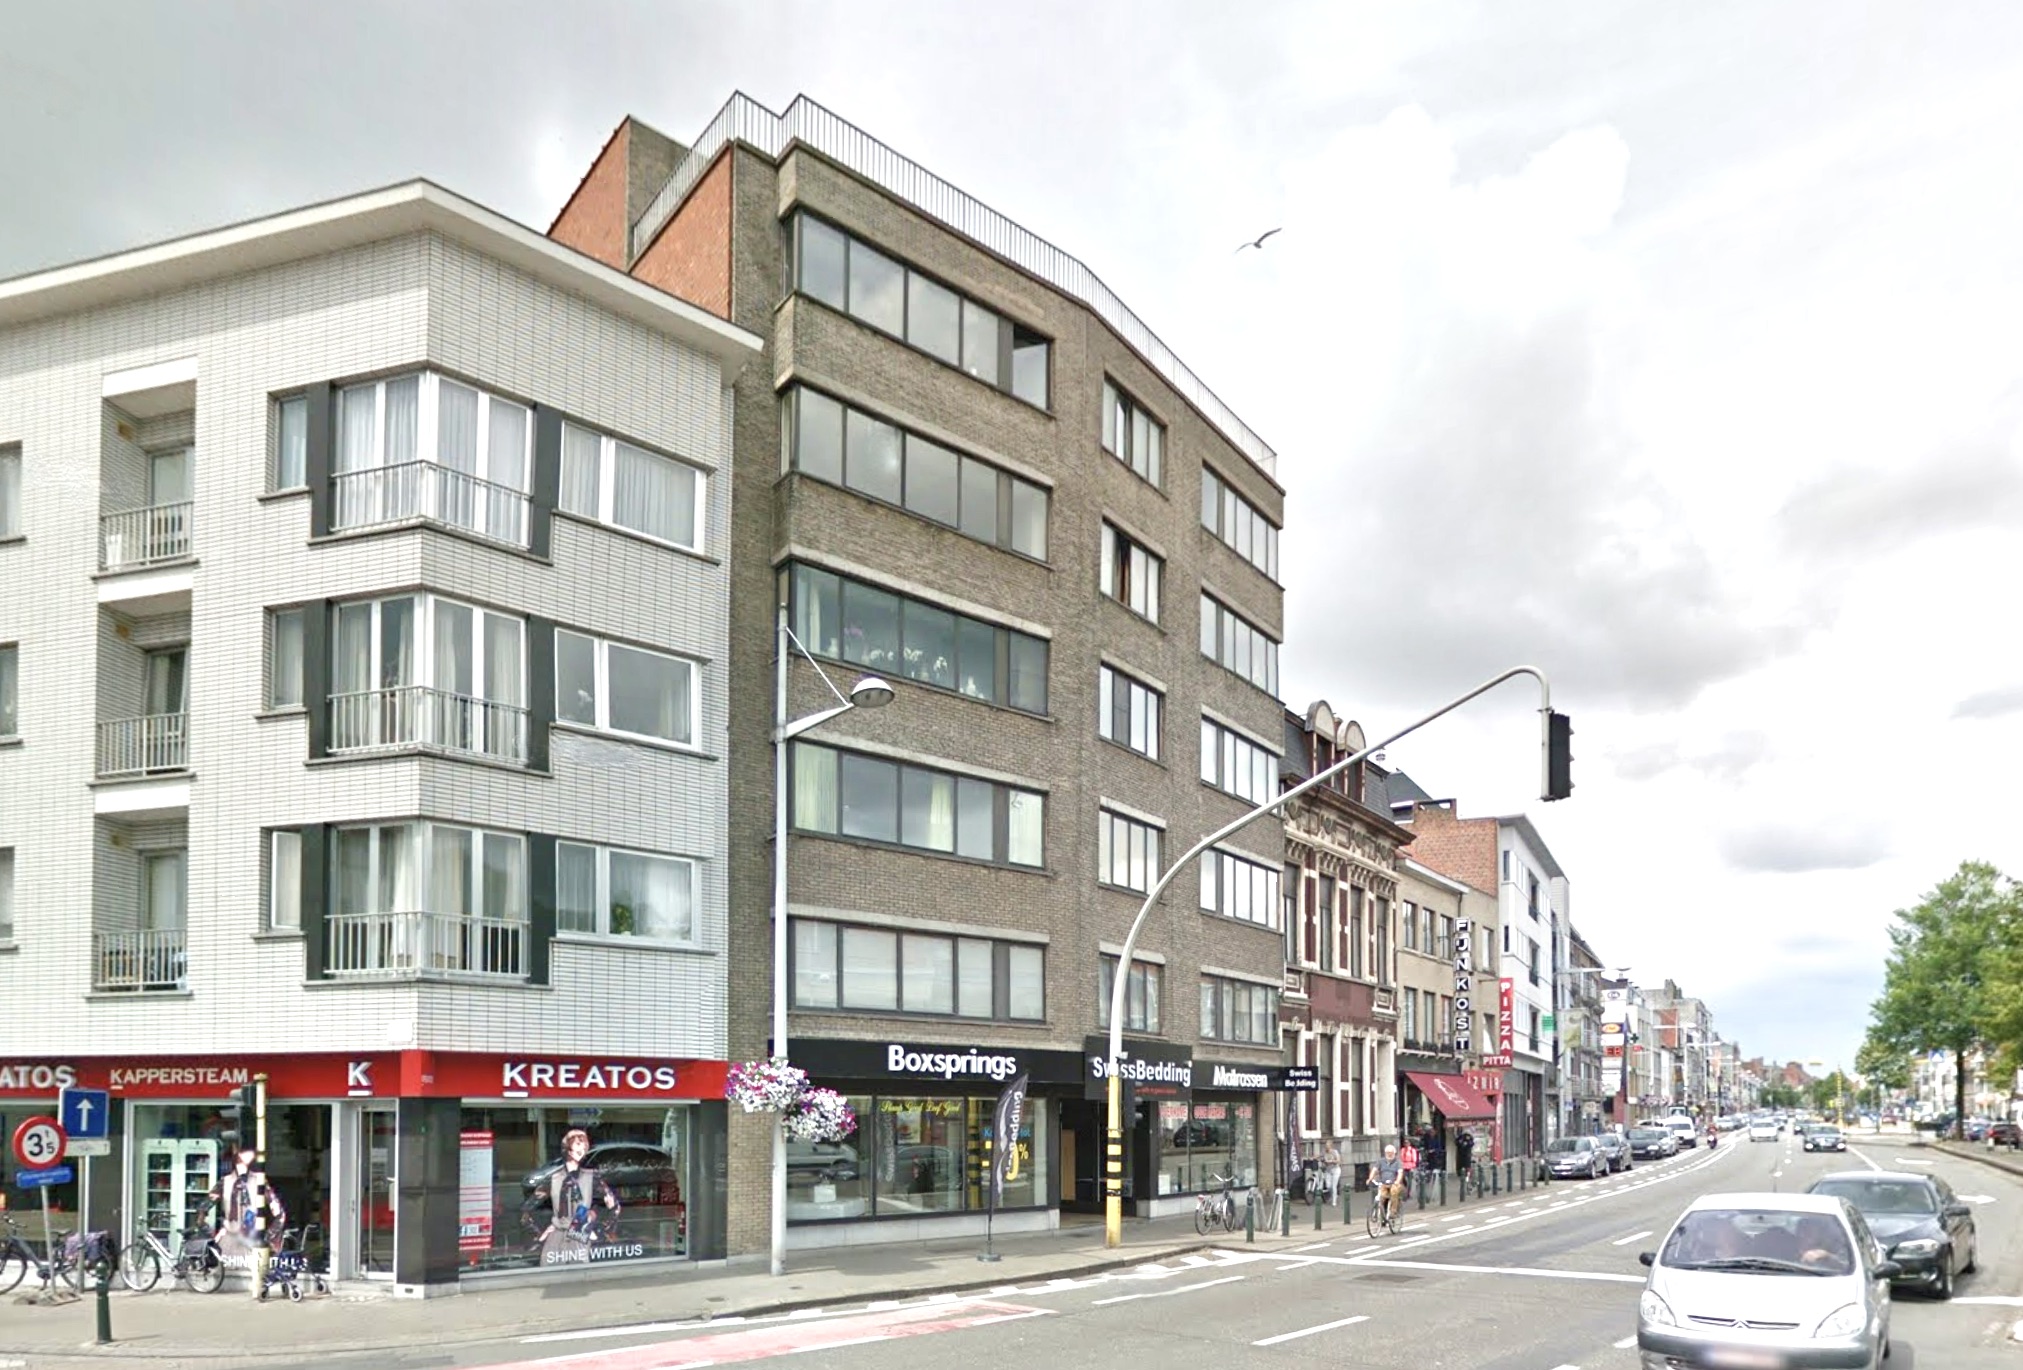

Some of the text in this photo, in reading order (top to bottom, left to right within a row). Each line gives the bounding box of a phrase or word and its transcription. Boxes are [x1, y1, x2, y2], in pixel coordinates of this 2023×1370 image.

[1501, 982, 1511, 1050] PIZZA
[888, 1044, 1017, 1081] Boxsprings
[1092, 1057, 1191, 1087] SwssBedding
[1483, 1056, 1511, 1066] PITTA
[110, 1068, 248, 1085] KAPPERSTEAM
[347, 1061, 374, 1087] K
[502, 1062, 676, 1090] KREATOS
[1213, 1065, 1268, 1088] Matrassen
[1289, 1069, 1312, 1078] Swiss
[223, 1255, 251, 1268] SHIN
[546, 1244, 643, 1263] SHINE WITH US
